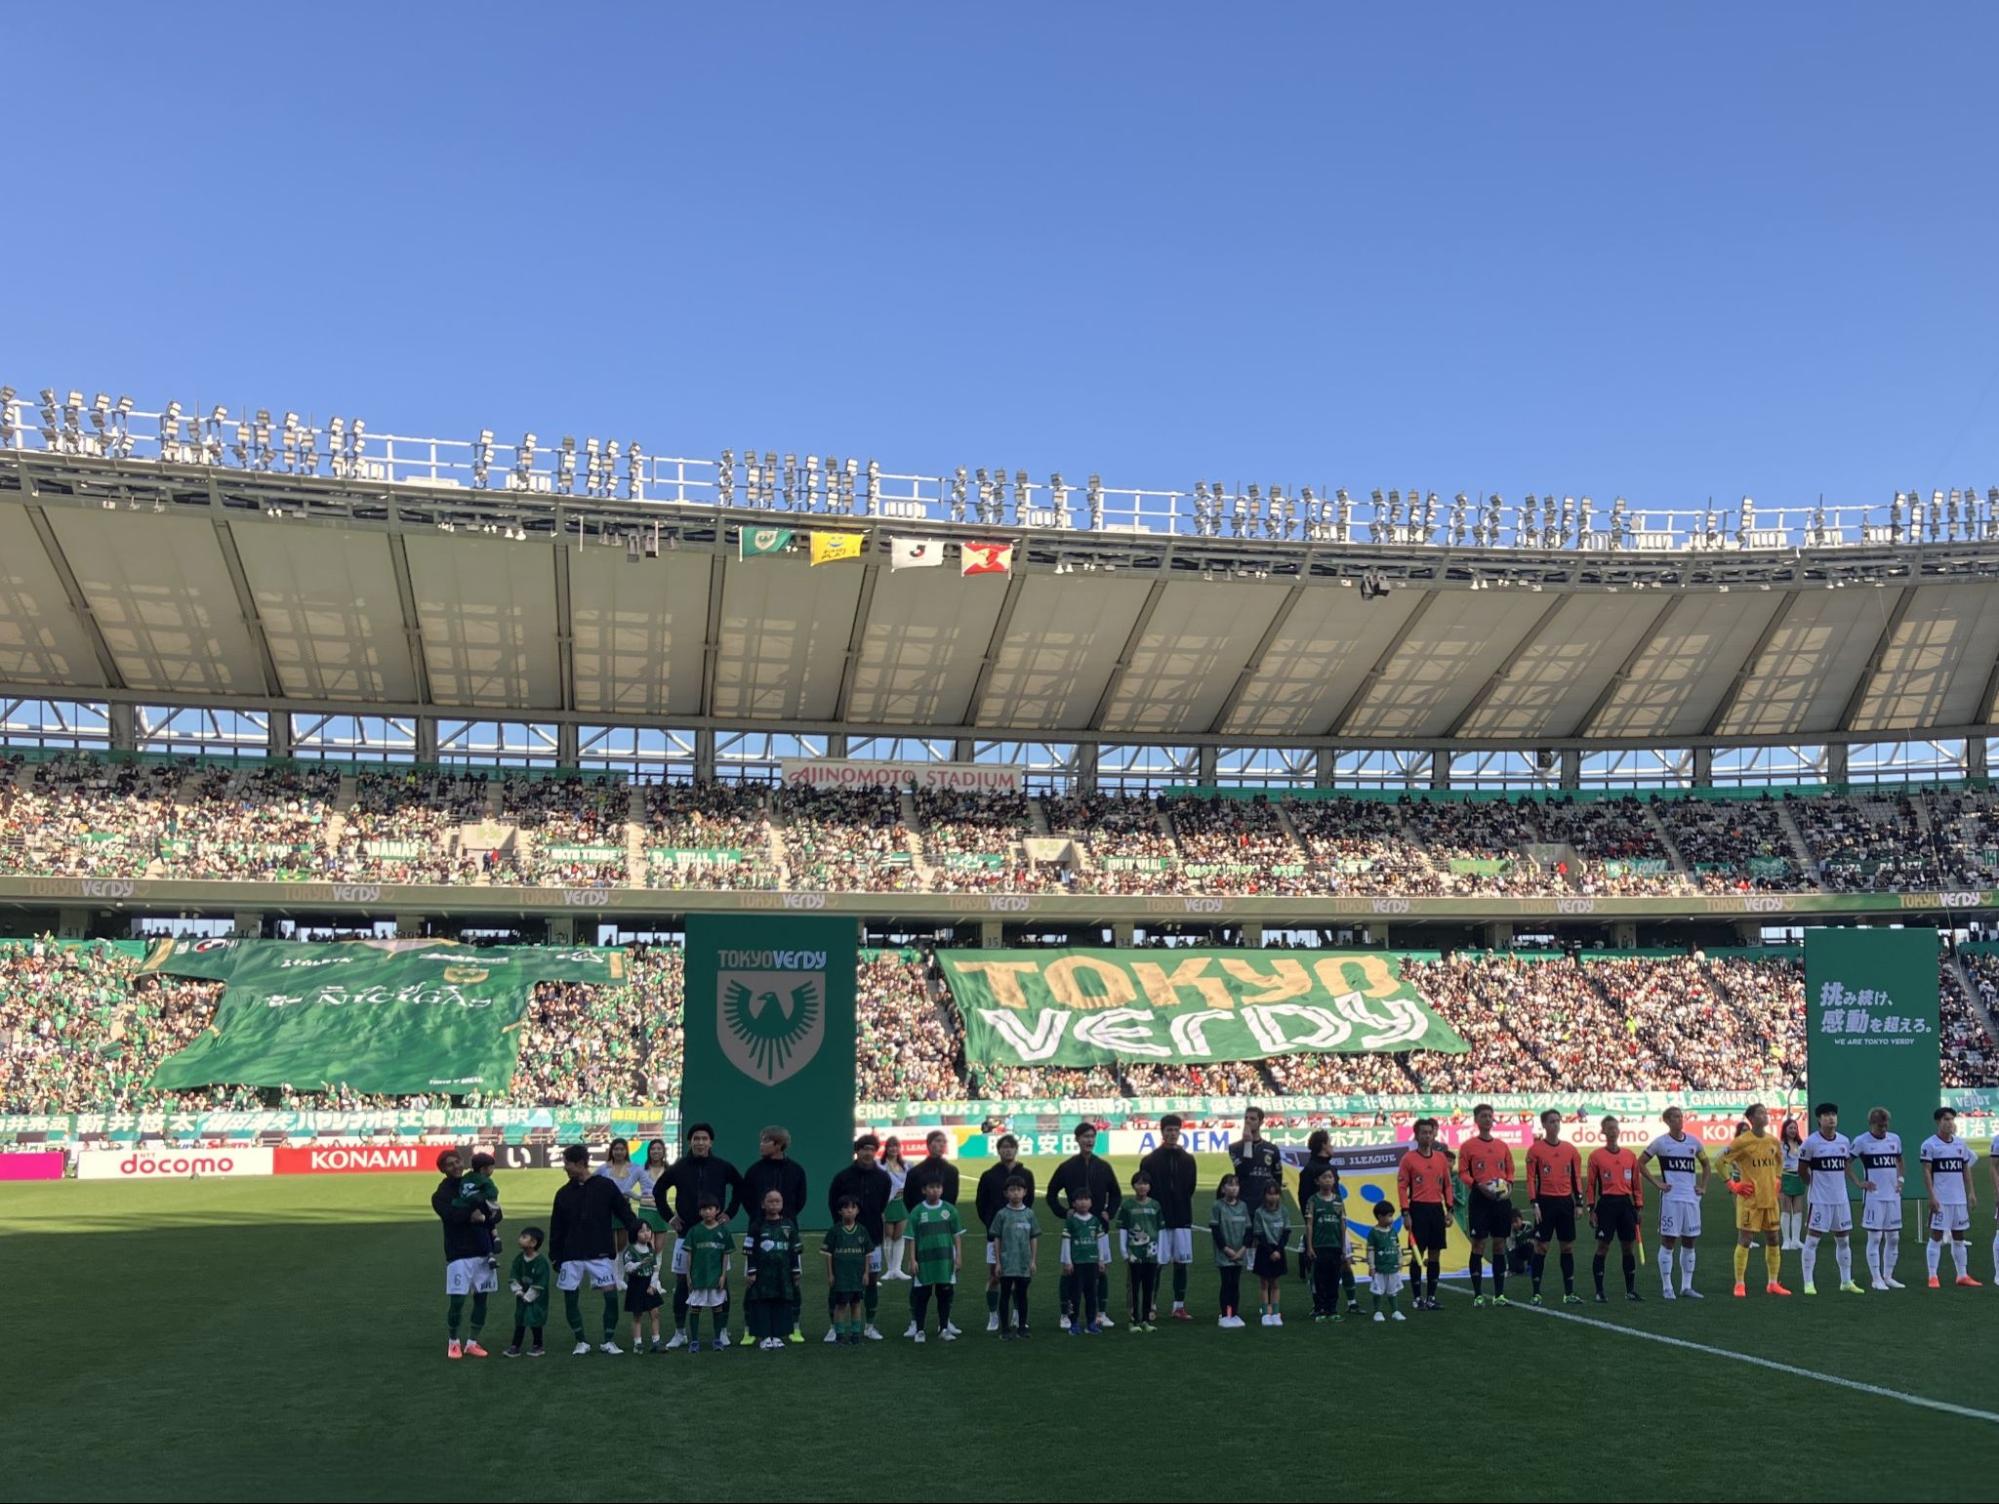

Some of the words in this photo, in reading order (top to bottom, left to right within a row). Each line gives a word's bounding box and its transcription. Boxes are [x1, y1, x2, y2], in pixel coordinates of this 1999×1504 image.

[788, 766, 916, 784] AJINOMOTO
[927, 770, 1015, 787] STADIUM
[954, 955, 1400, 1010] TOKYO
[1820, 982, 1893, 1007] 挑み続け、
[978, 991, 1428, 1062] VERDY
[1821, 1009, 1932, 1034] 感動を超えろ。
[120, 1154, 233, 1174] docomo
[311, 1150, 417, 1170] KONAMI
[1668, 1159, 1695, 1170] LIXIL
